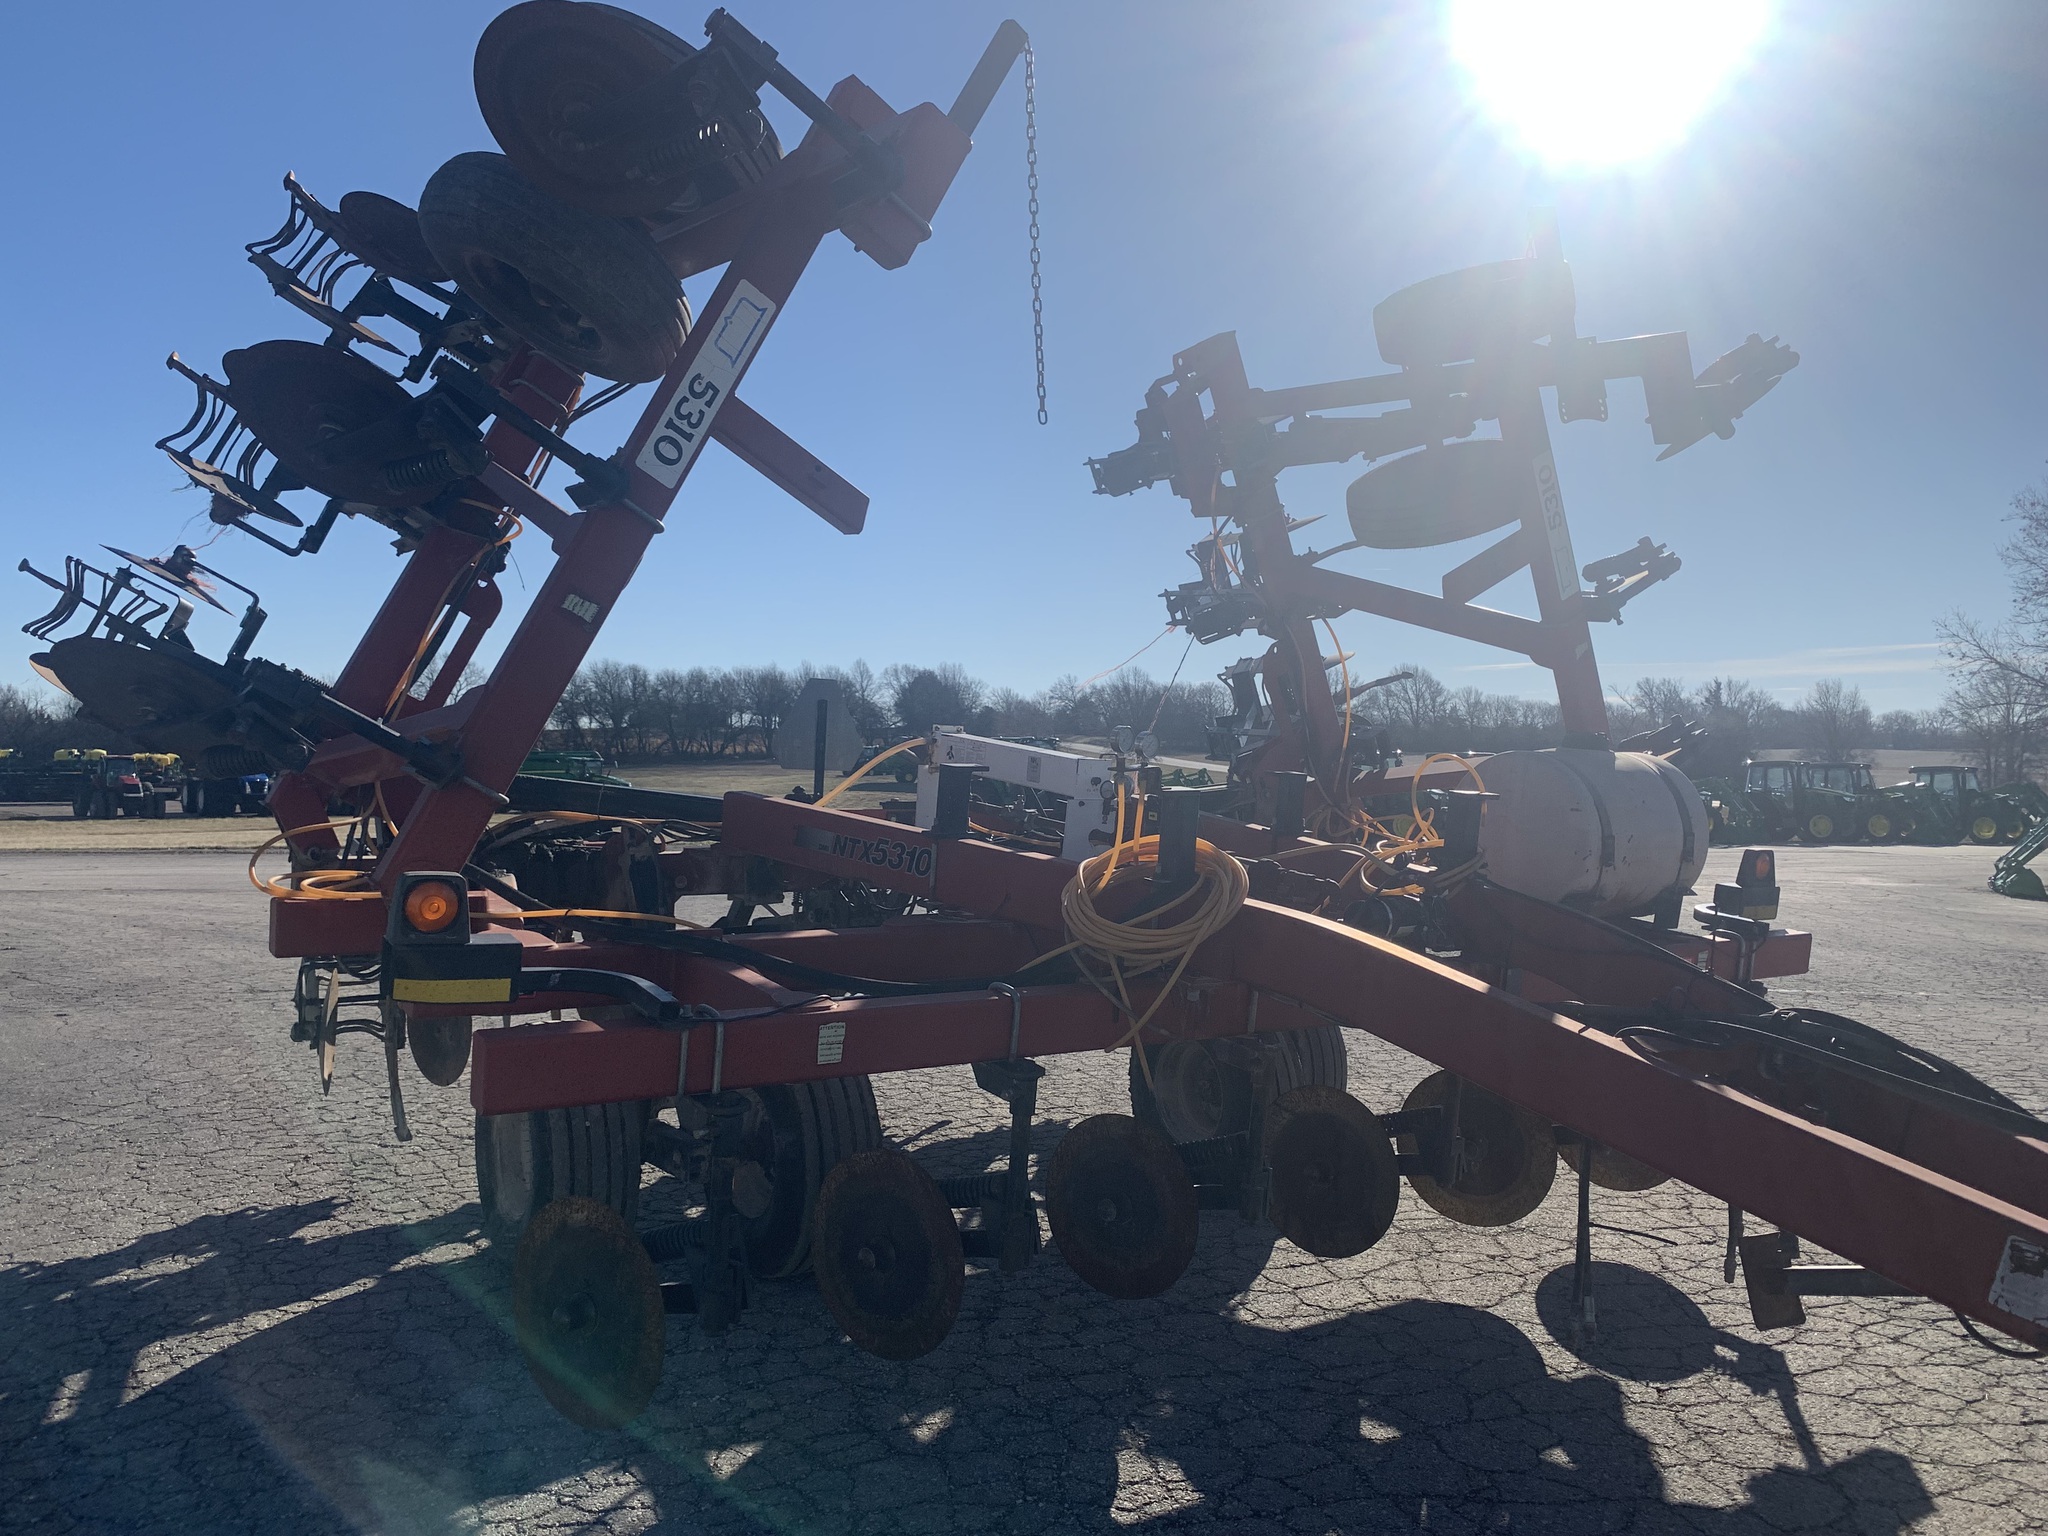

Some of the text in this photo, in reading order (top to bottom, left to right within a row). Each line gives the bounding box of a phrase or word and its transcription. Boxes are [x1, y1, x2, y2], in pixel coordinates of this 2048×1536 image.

[653, 372, 720, 467] 5310
[1538, 464, 1563, 531] 5310
[832, 834, 933, 878] NTX5310
